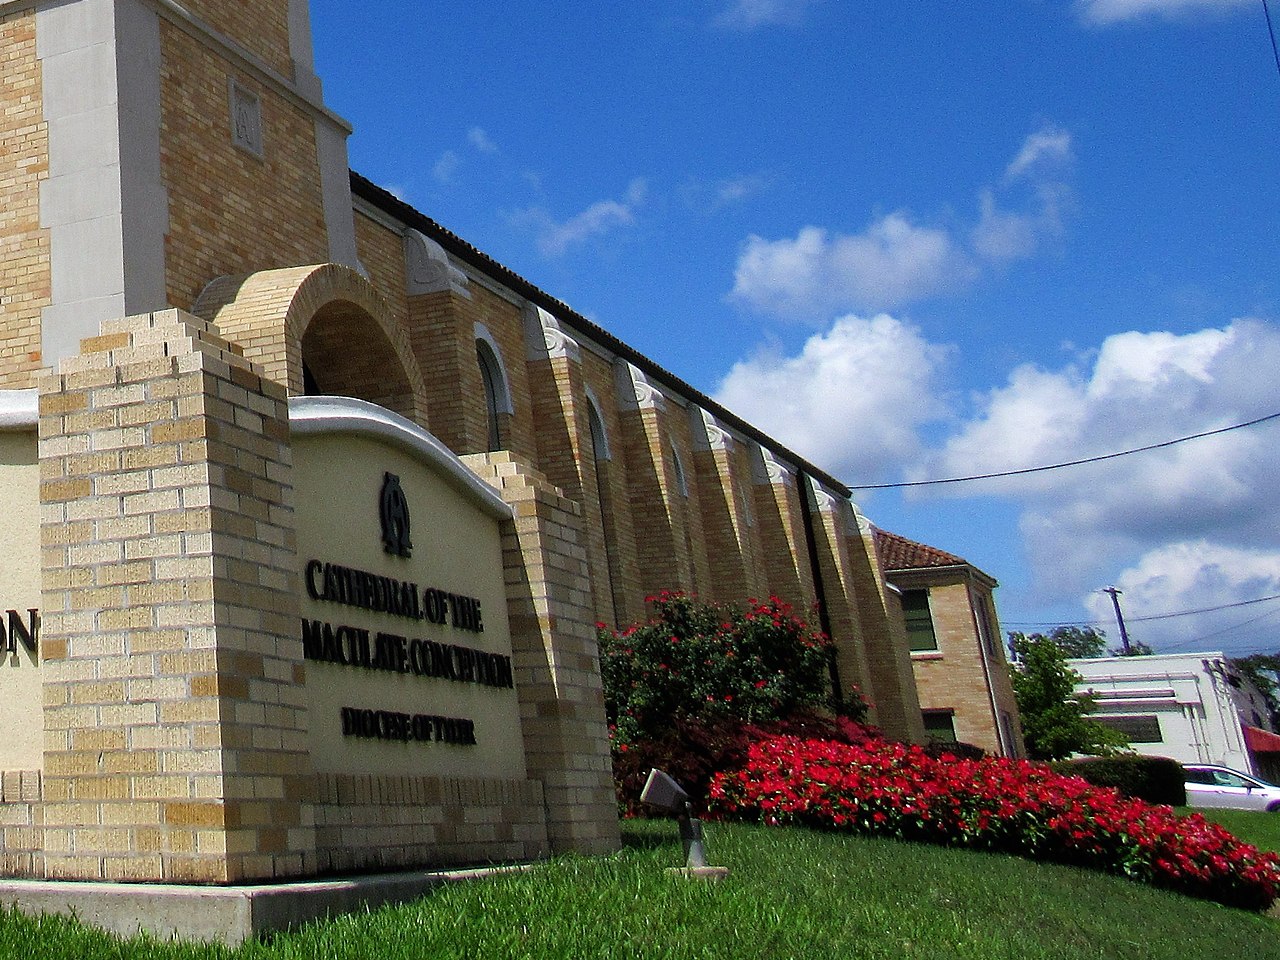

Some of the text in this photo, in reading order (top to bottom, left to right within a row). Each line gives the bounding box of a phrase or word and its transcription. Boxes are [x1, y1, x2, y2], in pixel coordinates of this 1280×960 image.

[305, 559, 484, 633] CATHEDRAL OF THE
